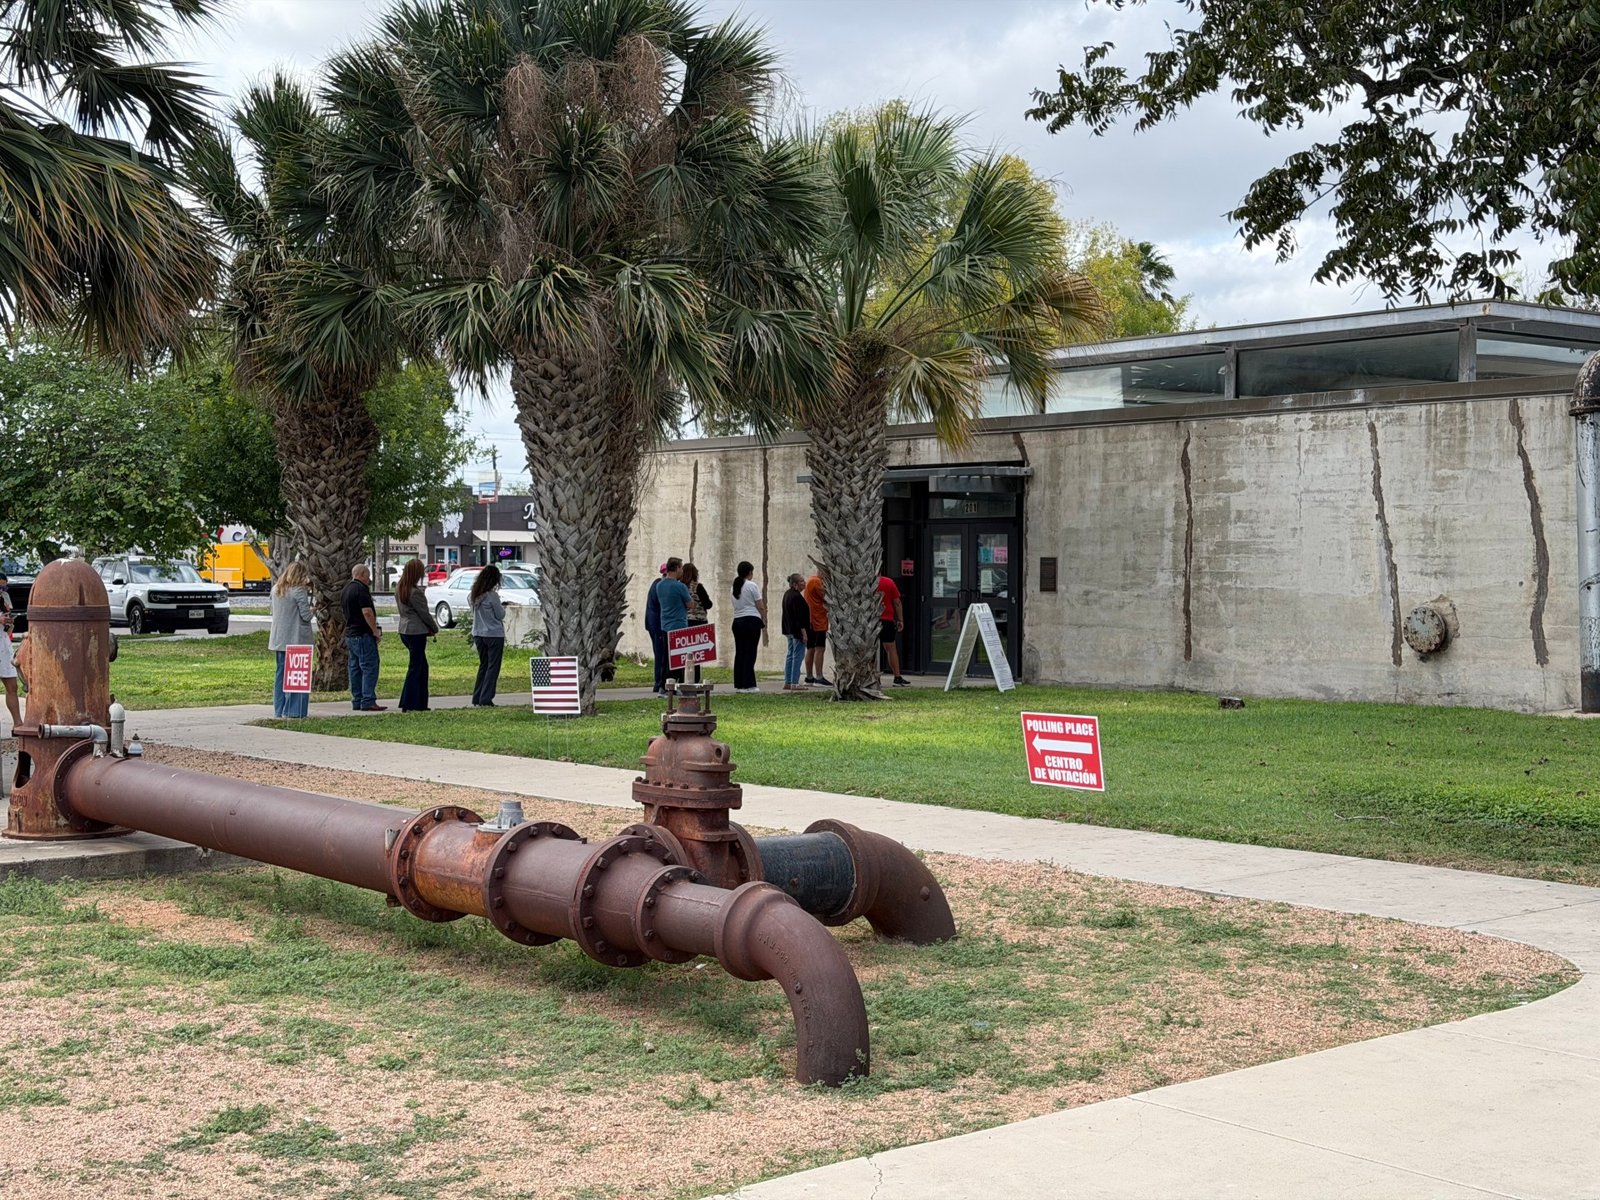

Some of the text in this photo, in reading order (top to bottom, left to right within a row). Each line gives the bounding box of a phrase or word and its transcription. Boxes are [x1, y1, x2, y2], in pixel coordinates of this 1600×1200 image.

[675, 632, 709, 648] POLLING
[289, 653, 309, 668] VOTE
[287, 671, 308, 686] HERE
[1026, 719, 1094, 736] POLLING PLACE
[1044, 755, 1083, 770] CENTRO
[1034, 767, 1097, 785] DE VOTACIÓN
